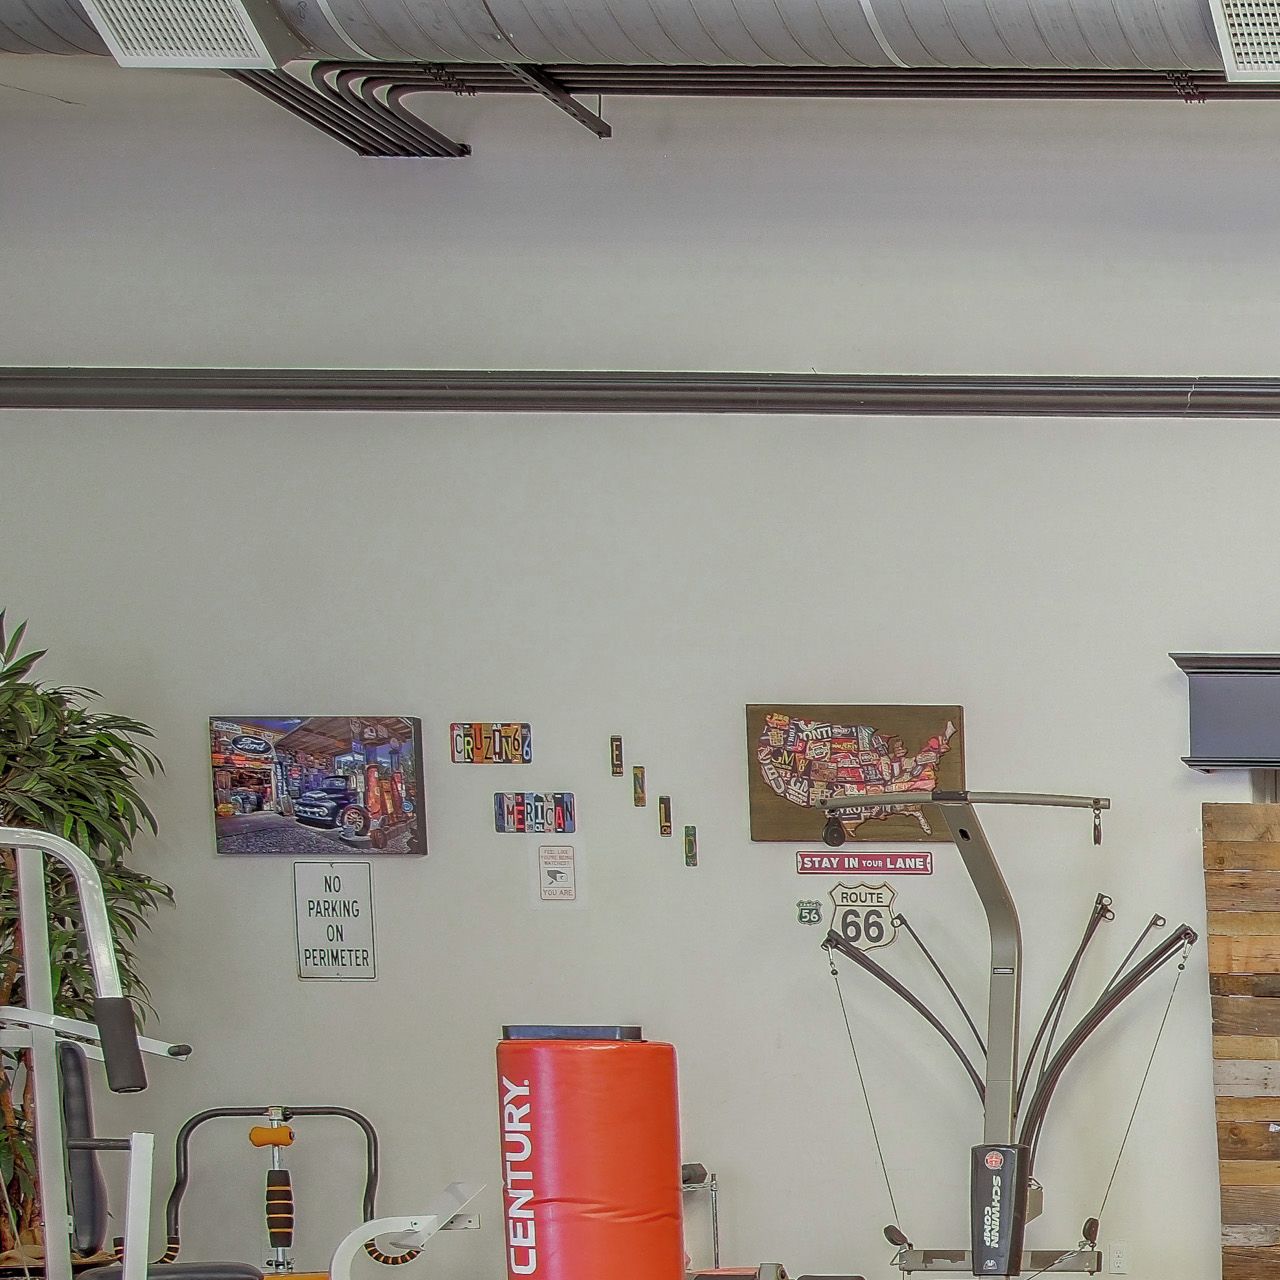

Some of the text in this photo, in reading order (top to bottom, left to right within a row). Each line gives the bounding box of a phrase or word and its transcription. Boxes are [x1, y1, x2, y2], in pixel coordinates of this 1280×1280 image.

[803, 857, 925, 869] STAY IN YOUR LANE
[323, 875, 341, 893] NO
[841, 891, 884, 904] ROUTE
[308, 900, 360, 917] PARKING
[801, 909, 819, 922] 56
[326, 924, 344, 942] ON
[841, 908, 885, 943] 66
[304, 948, 369, 967] PERIMETER
[990, 1175, 1001, 1248] SCHWINN
[984, 1206, 992, 1247] COMP
